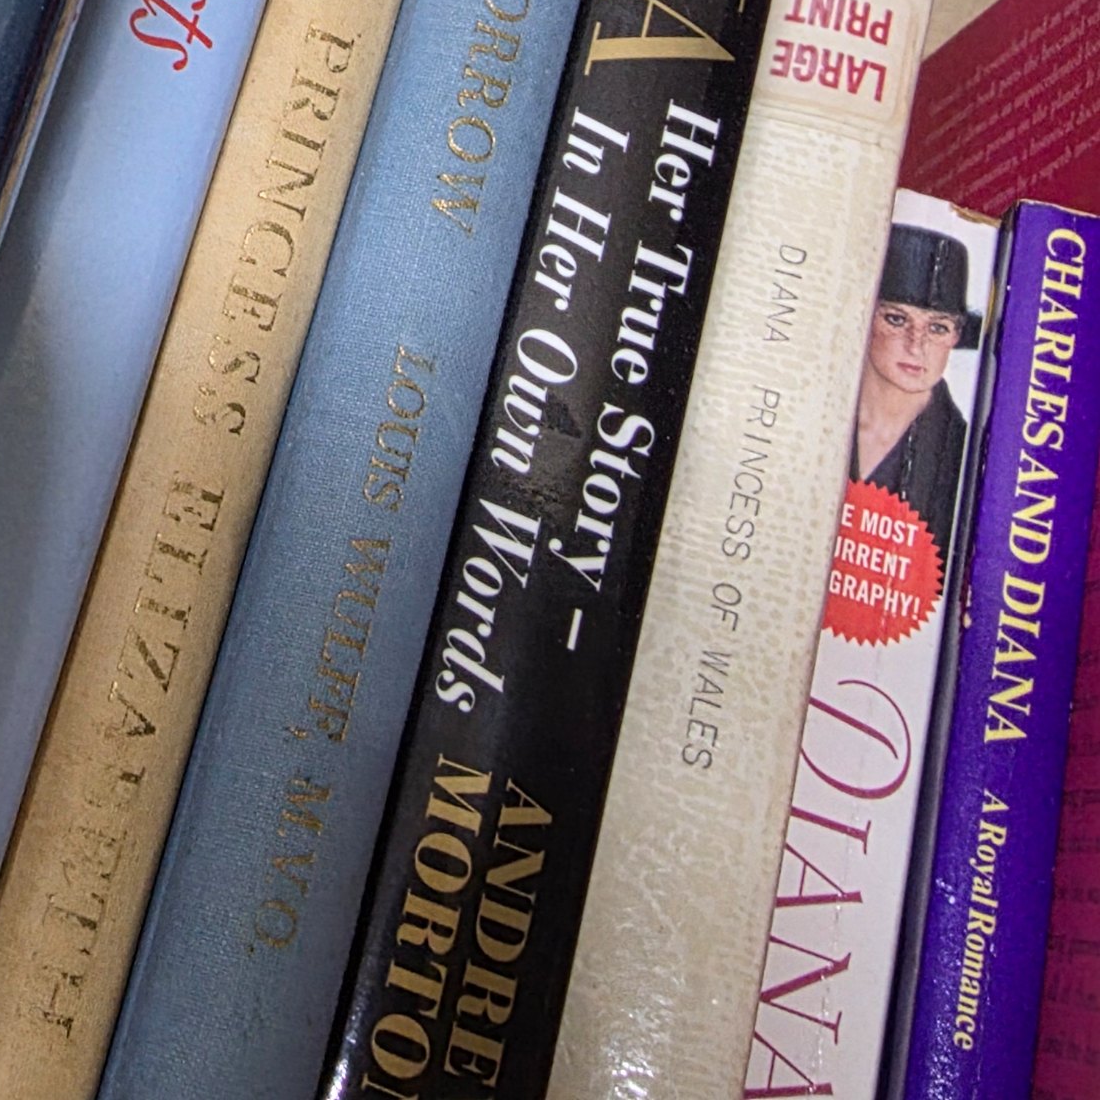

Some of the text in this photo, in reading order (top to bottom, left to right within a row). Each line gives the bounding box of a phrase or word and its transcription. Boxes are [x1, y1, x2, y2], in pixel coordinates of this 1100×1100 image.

[649, 99, 722, 222] Her
[769, 39, 887, 101] LARGE
[194, 21, 362, 438] PRINCESS
[611, 241, 694, 384] True
[364, 344, 438, 513] LOUIS
[436, 107, 631, 713] In Her Own Words
[549, 402, 656, 593] Story
[682, 242, 807, 772] DIANA PRINCESS OF WALES
[829, 570, 922, 621] GRAPHY!
[860, 509, 919, 547] MOST
[953, 227, 1087, 1052] CHARLES AND DIANA A Royal Romance
[444, 777, 552, 1100] ANDRE
[743, 679, 912, 1098] DIANA
